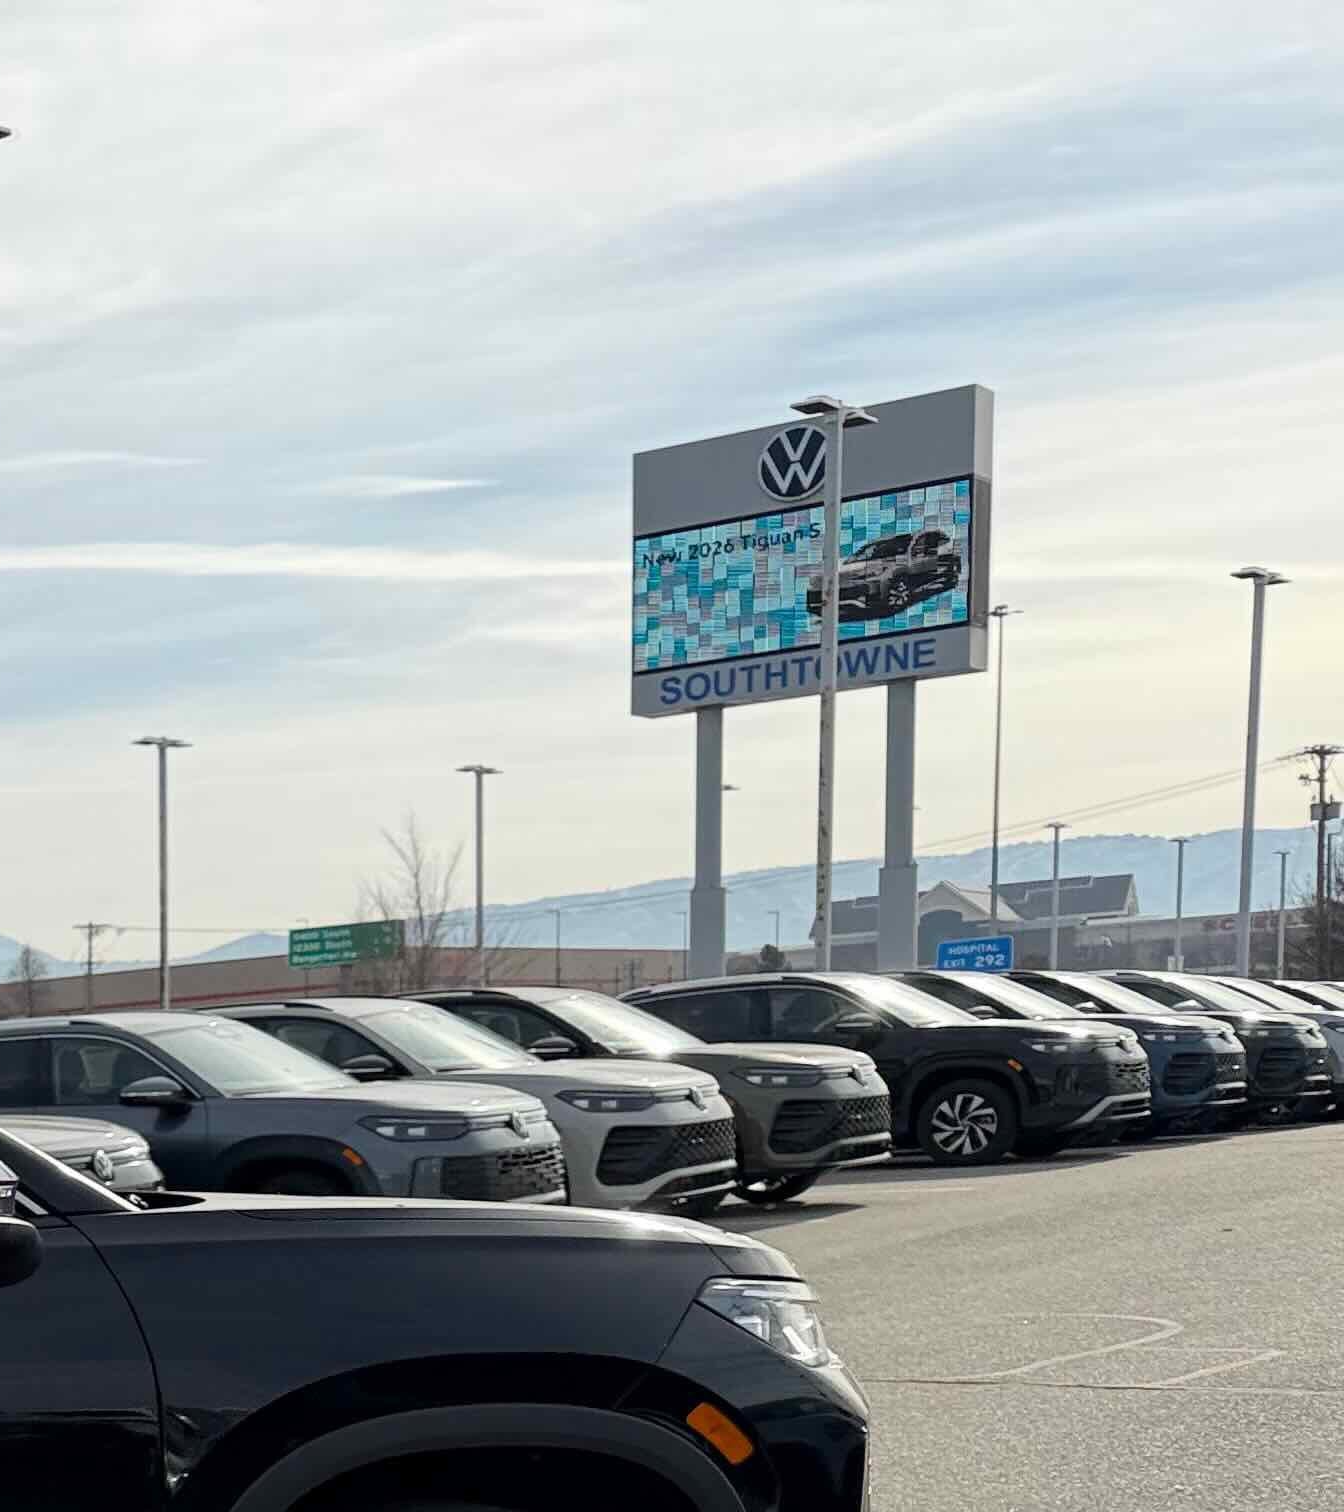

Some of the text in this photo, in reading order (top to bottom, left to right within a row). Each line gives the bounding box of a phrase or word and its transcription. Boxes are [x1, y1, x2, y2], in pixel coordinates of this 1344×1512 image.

[759, 424, 826, 500] VW
[688, 540, 735, 560] 2026
[740, 528, 803, 550] Tiguan
[809, 522, 821, 539] S
[947, 943, 1000, 955] HOSPITAL
[975, 954, 1005, 968] 292
